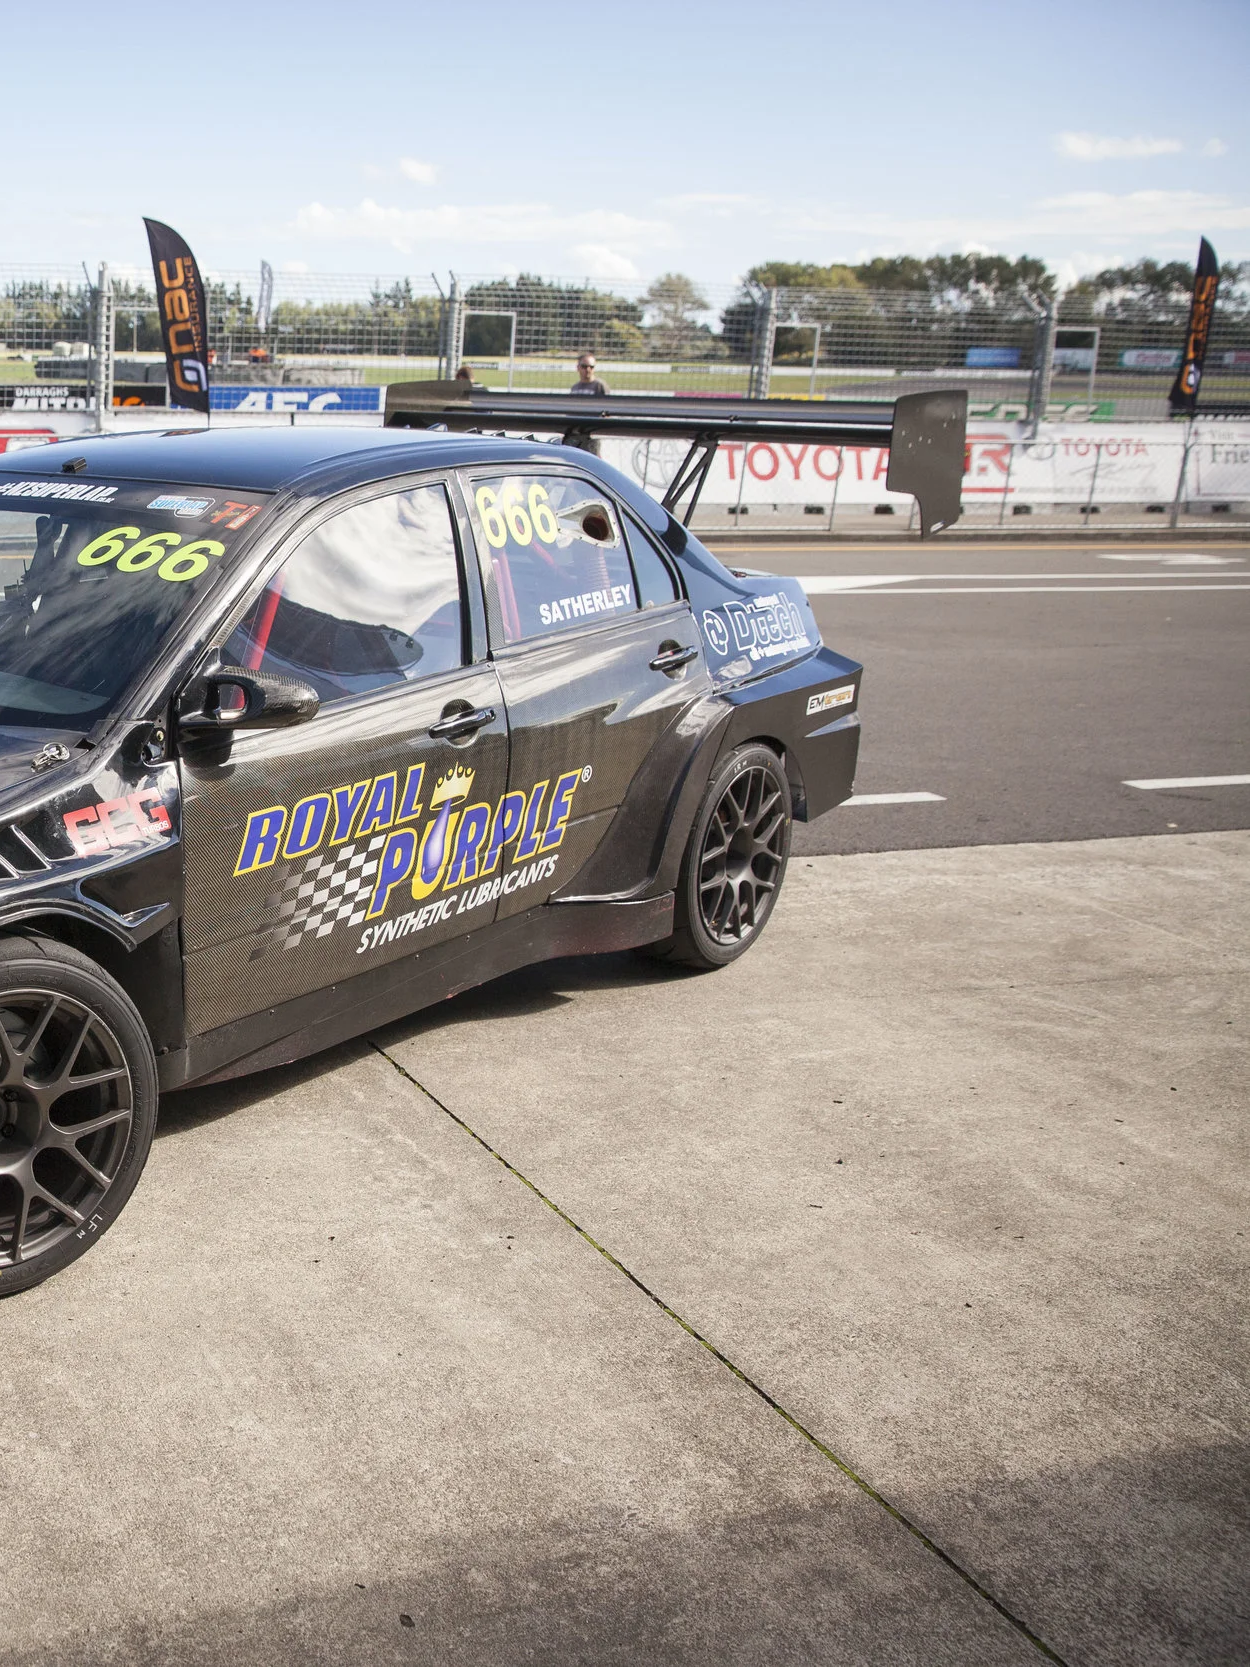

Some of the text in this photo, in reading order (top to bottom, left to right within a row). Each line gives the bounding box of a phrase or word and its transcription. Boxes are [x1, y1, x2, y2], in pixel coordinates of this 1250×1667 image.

[15, 386, 70, 398] DARRAGHS
[1061, 438, 1149, 457] TOYOTA
[475, 483, 558, 549] 666
[77, 526, 226, 582] 666
[539, 584, 631, 625] SATHERLEY
[233, 762, 426, 877] ROYAL
[365, 768, 583, 921] PURPLE
[356, 854, 559, 954] SYNTHETIC LUBRICANTS
